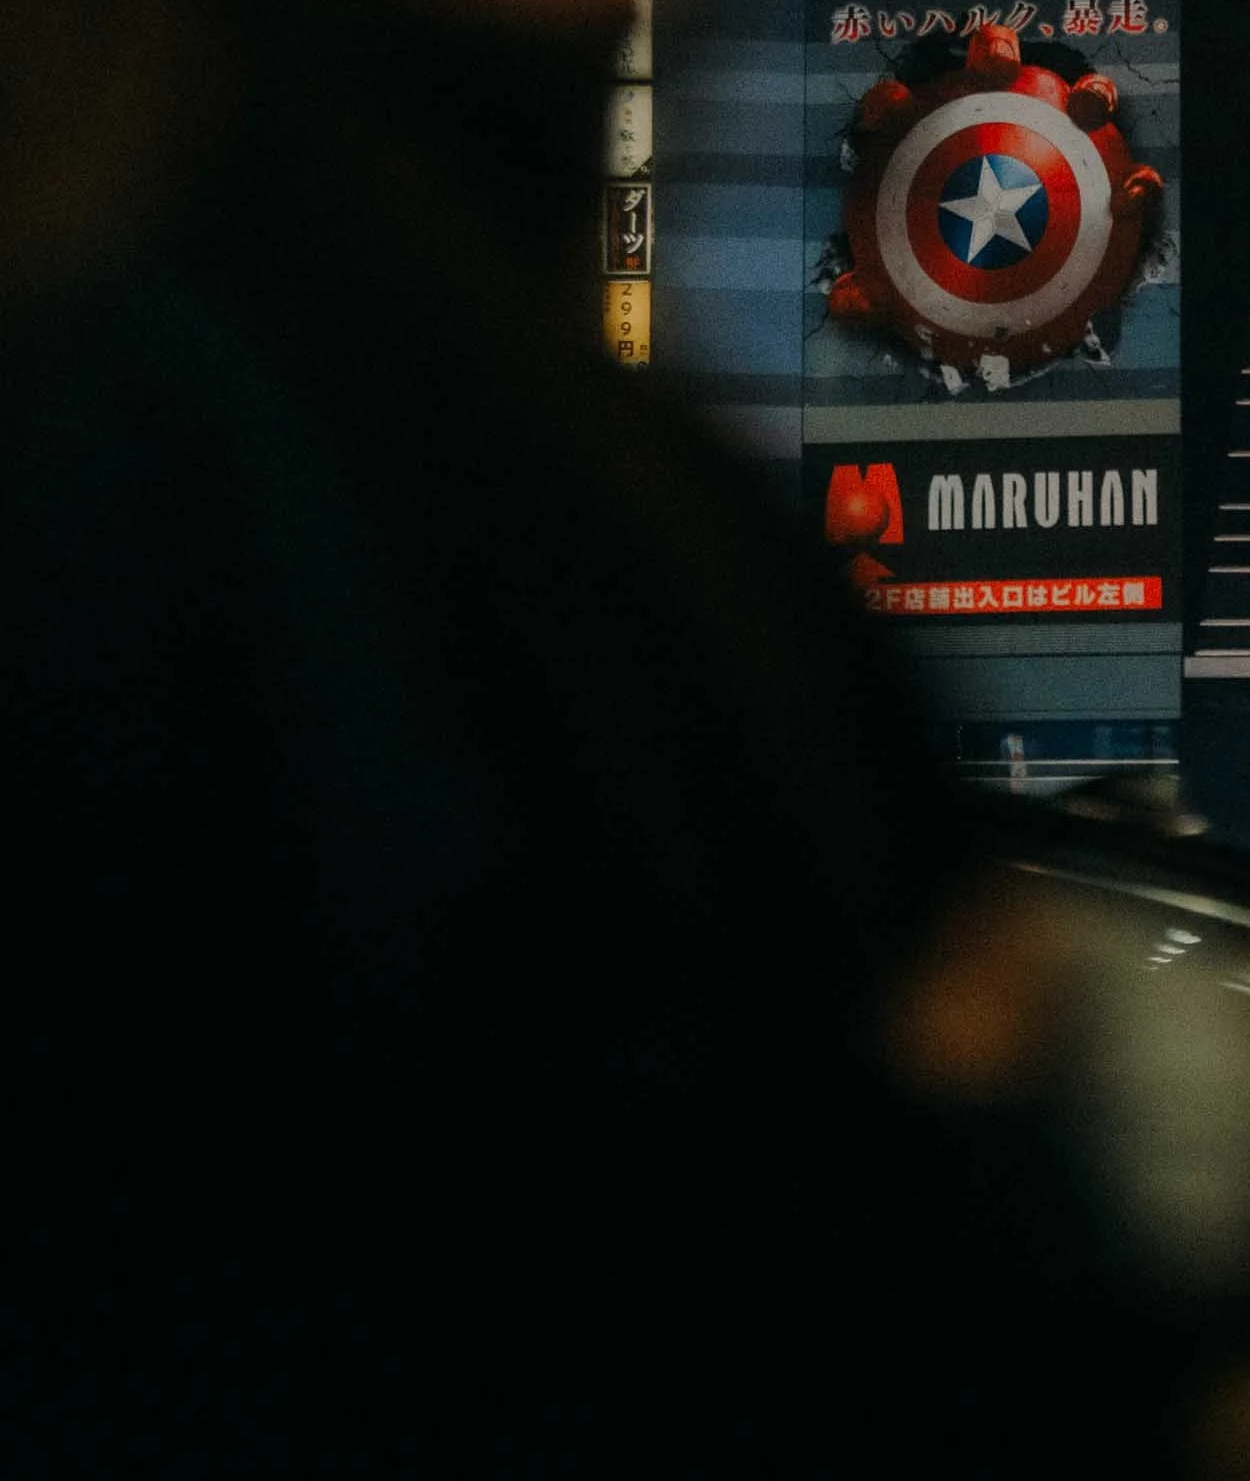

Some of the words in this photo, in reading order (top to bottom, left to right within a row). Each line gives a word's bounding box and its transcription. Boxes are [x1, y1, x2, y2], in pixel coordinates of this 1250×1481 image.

[622, 188, 646, 254] ダーツ
[928, 469, 1158, 531] MARUHAN
